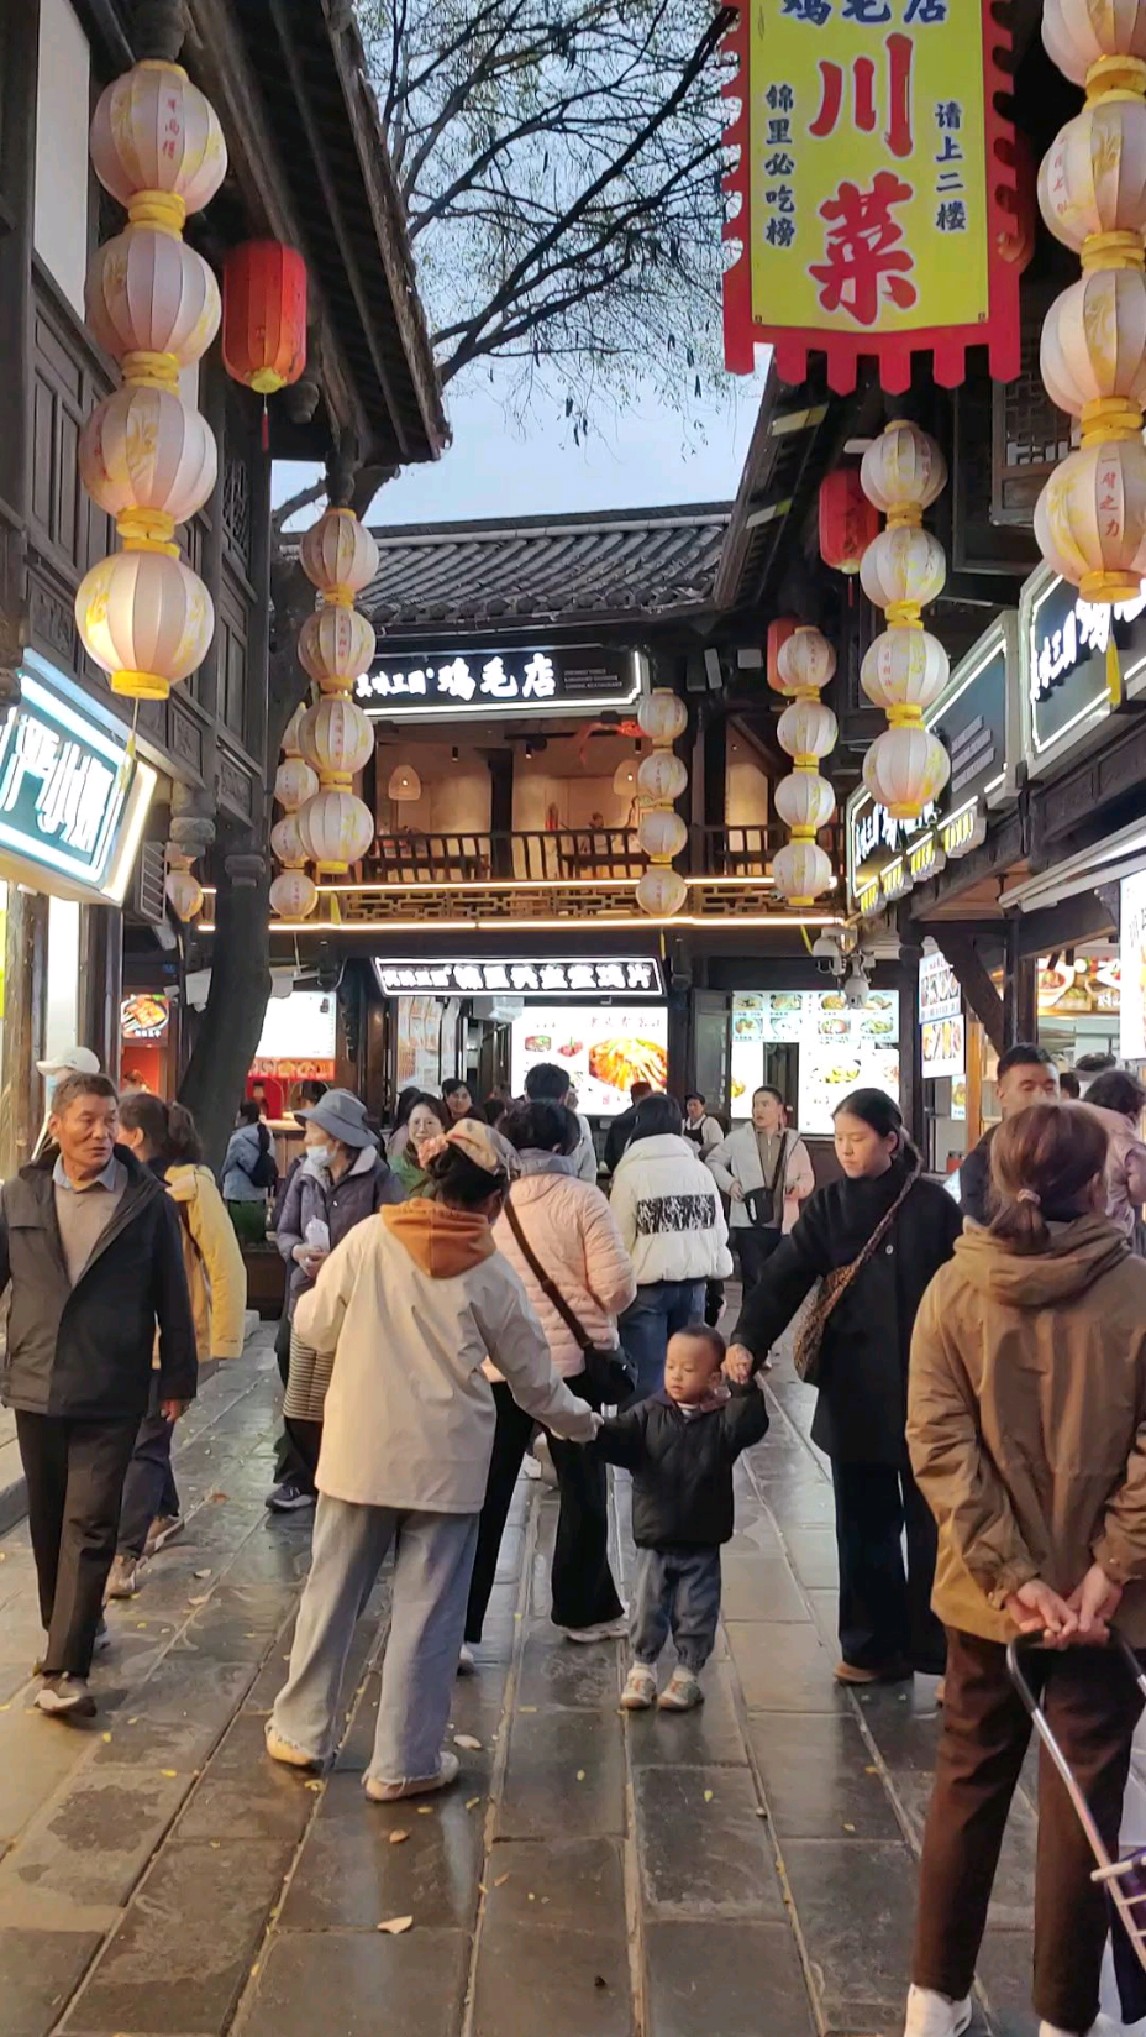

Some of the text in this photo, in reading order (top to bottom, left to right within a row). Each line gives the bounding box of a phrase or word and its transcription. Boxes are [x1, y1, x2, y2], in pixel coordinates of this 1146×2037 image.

[765, 84, 795, 247] 锦里必吃榜
[808, 31, 917, 325] 川菜
[935, 101, 967, 231] 请上二楼
